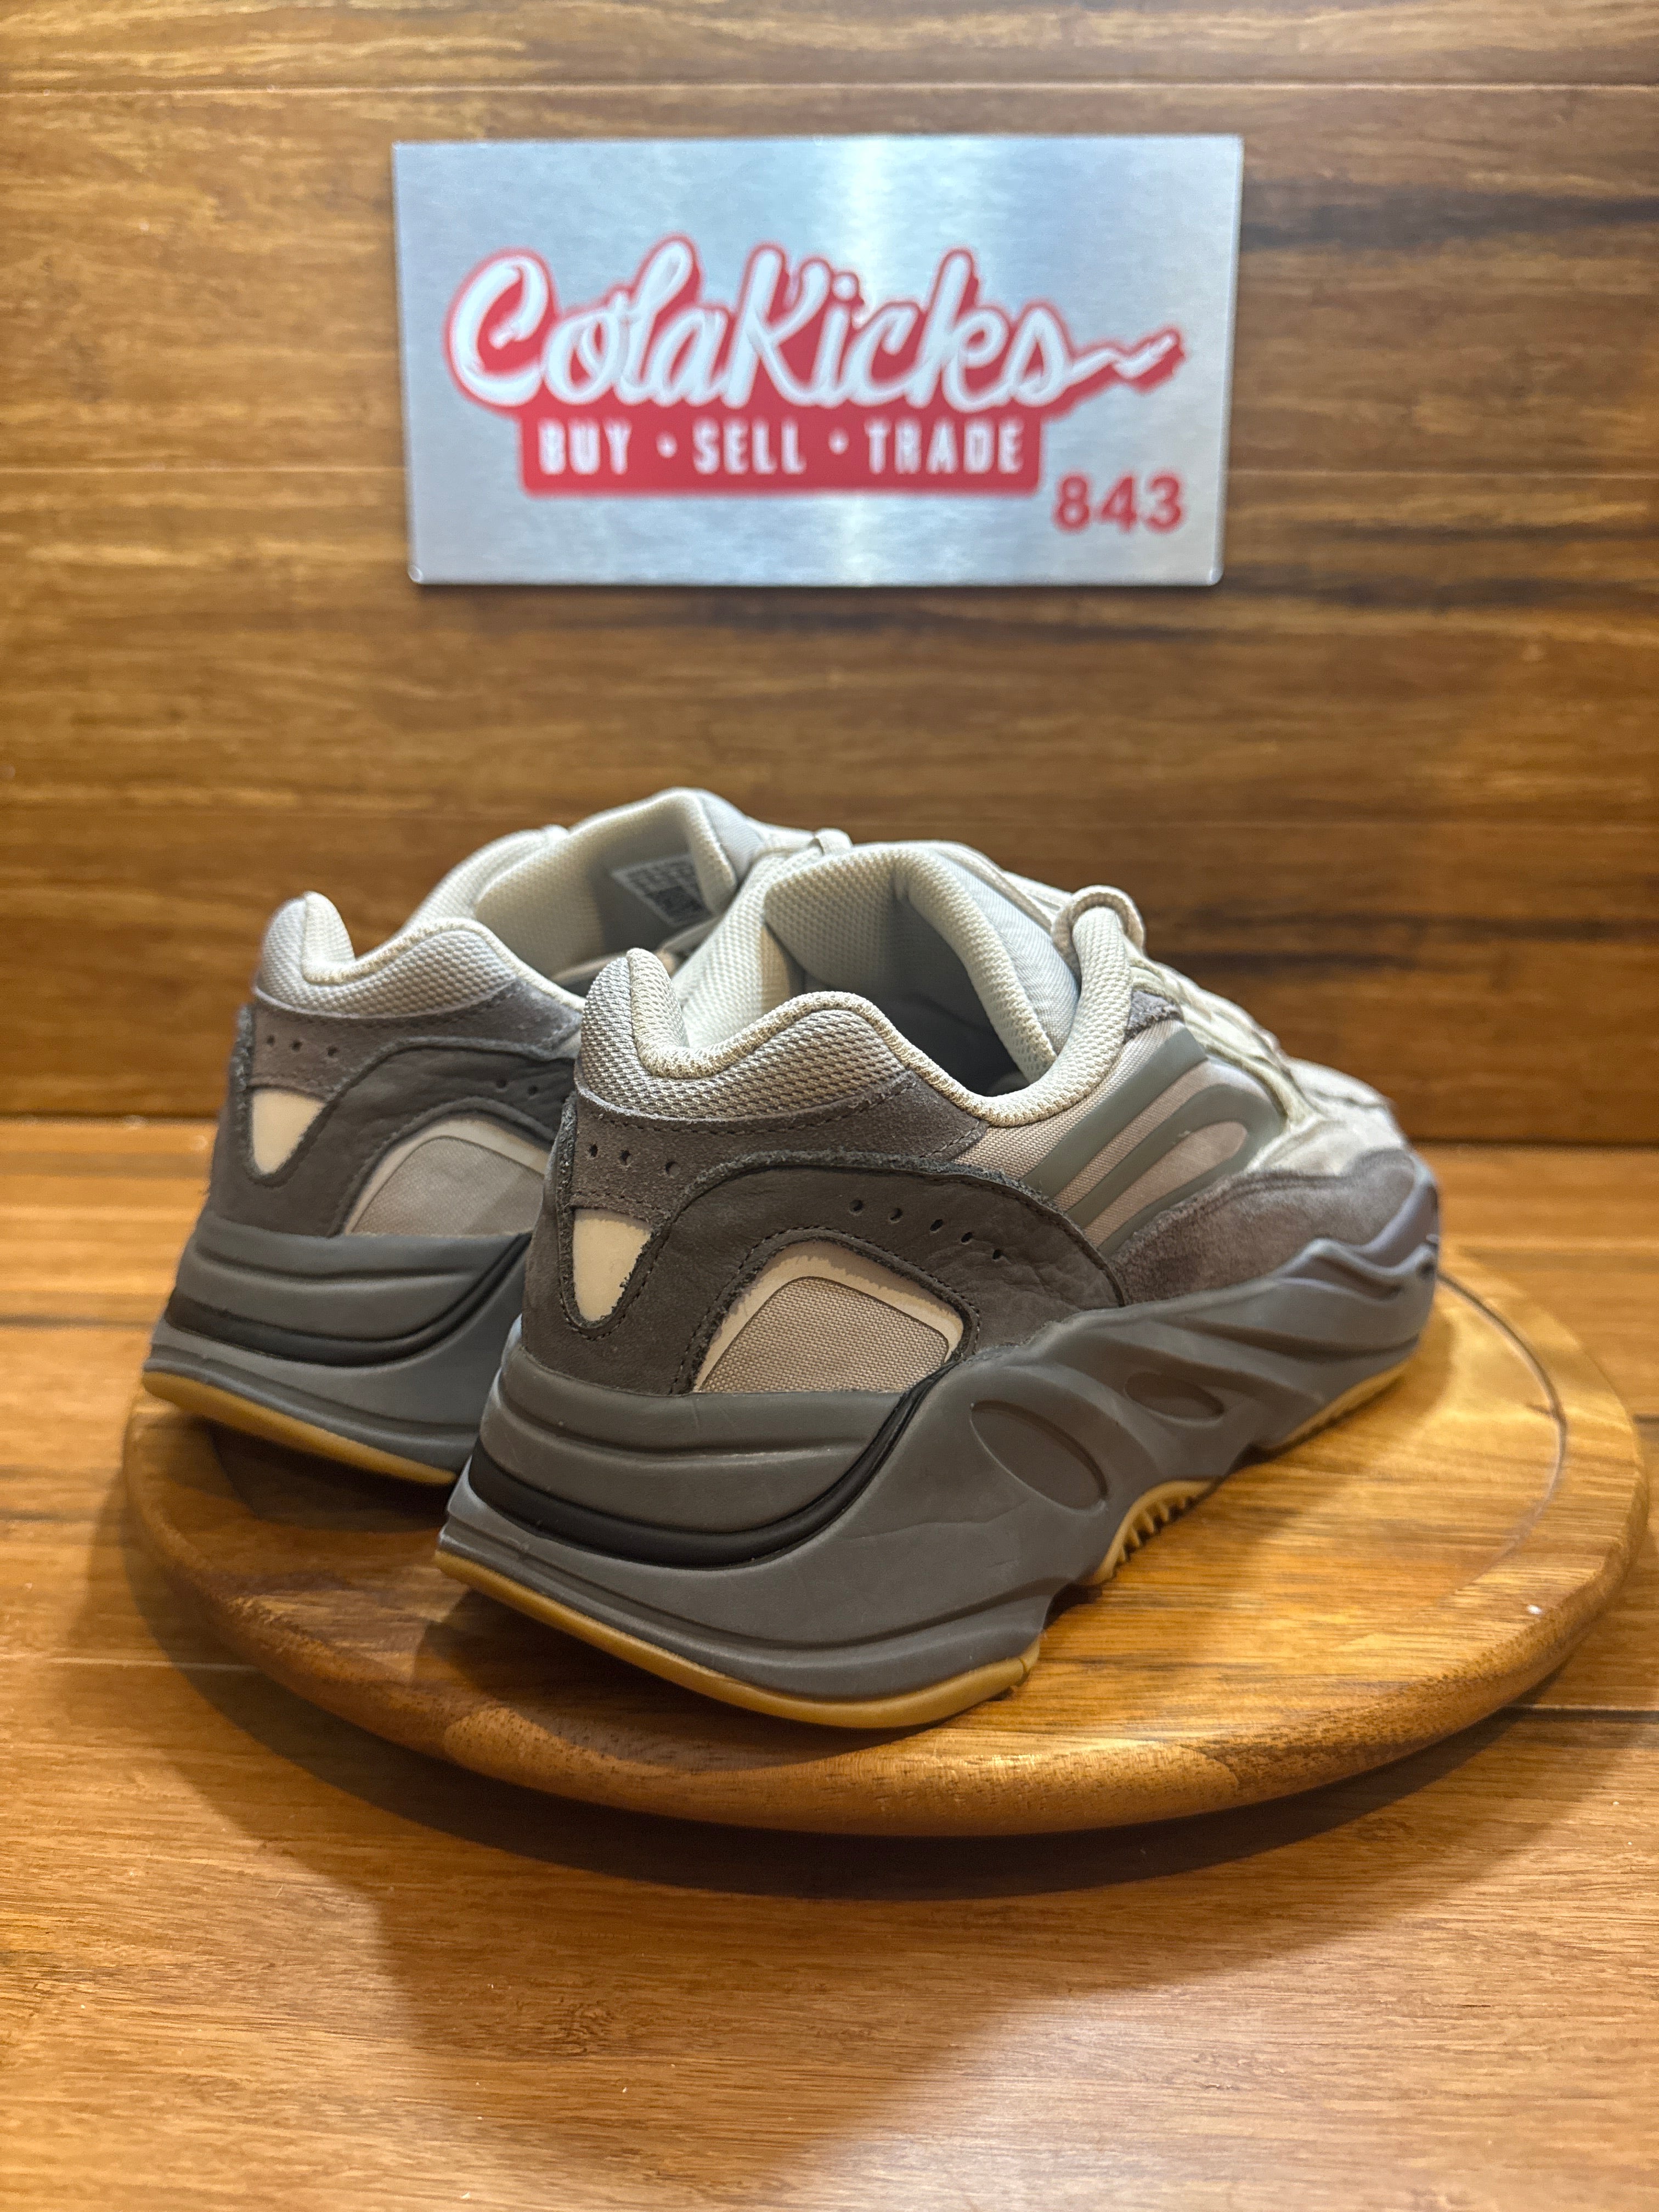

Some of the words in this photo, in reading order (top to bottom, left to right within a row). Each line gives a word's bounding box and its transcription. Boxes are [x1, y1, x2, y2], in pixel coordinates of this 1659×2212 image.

[448, 235, 1184, 415] ColaKicks
[539, 419, 631, 476] BUY
[692, 418, 806, 476] SELL
[867, 417, 1026, 475] TRADE
[1054, 474, 1185, 533] 843
